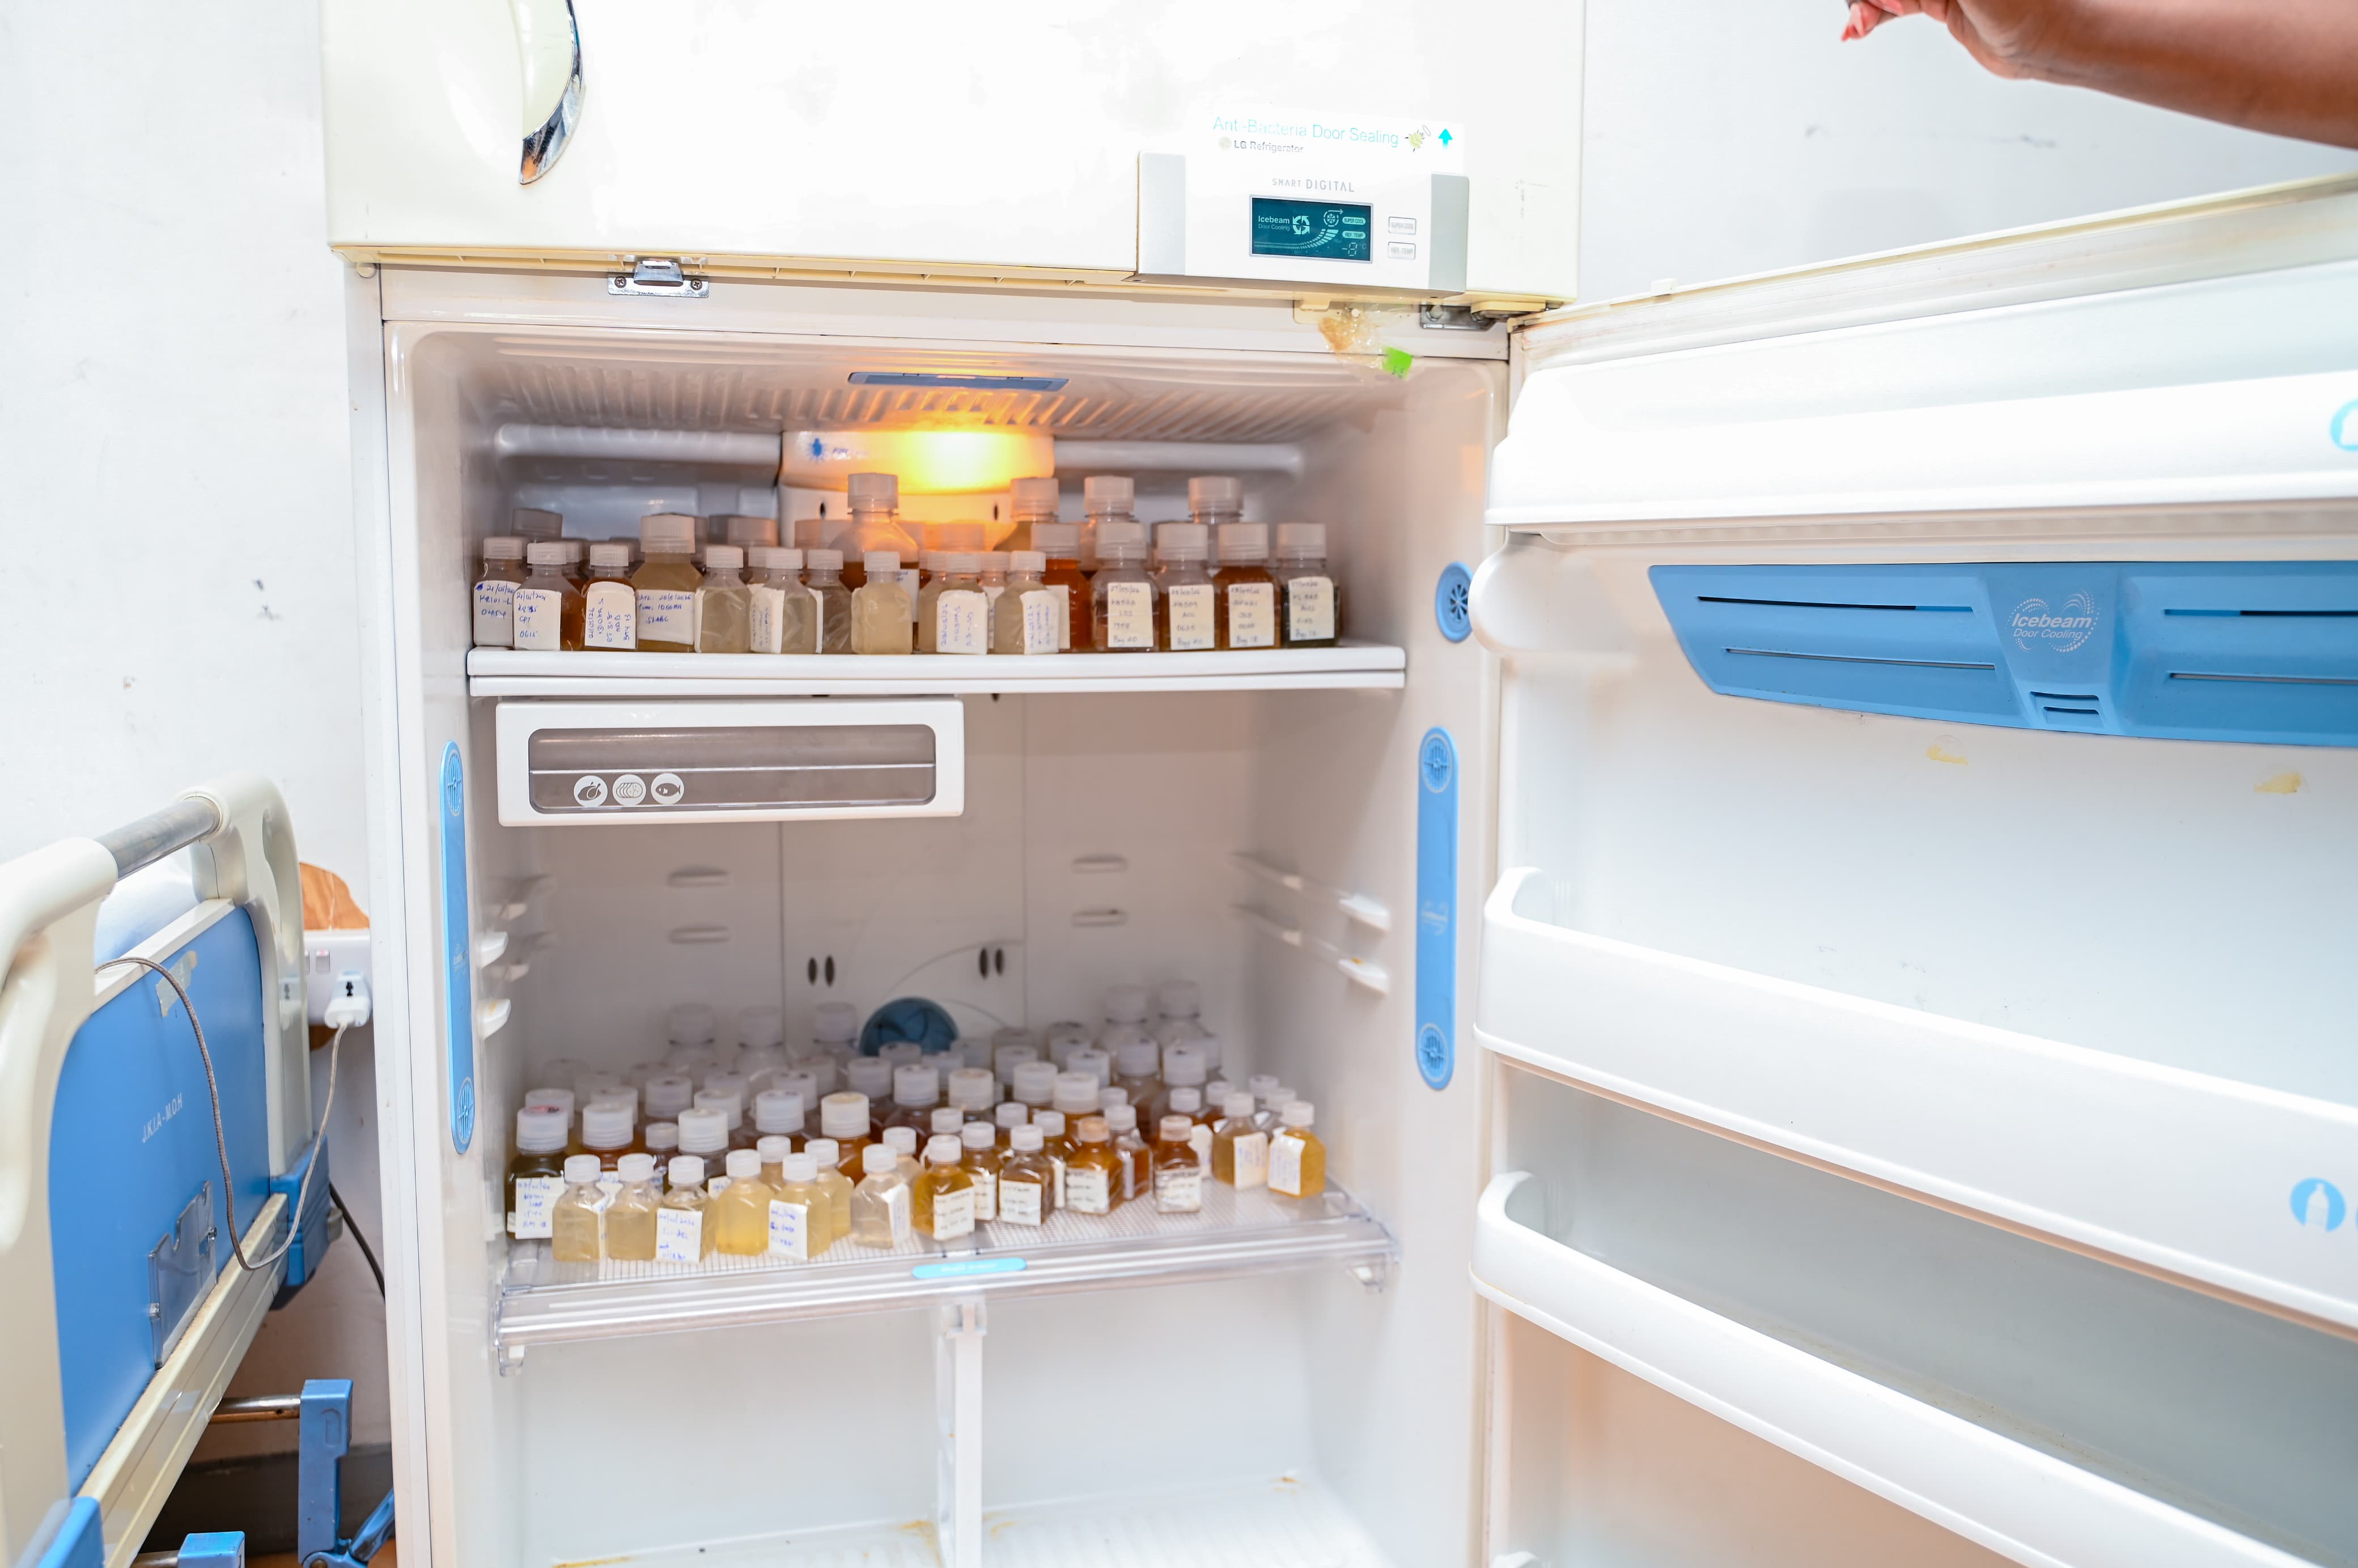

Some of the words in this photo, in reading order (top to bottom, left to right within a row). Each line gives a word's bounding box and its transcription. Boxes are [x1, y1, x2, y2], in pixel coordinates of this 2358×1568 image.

[1313, 124, 1345, 139] Door
[1350, 127, 1398, 148] Sealing
[1234, 140, 1247, 150] LG
[1250, 141, 1304, 154] Refrigerator
[1272, 178, 1301, 188] SMART
[1305, 179, 1355, 193] DIGITAL
[1258, 215, 1290, 224] Icebeam
[2012, 613, 2092, 628] Icebeam
[2013, 628, 2040, 638] Door
[2041, 628, 2084, 641] Cooling
